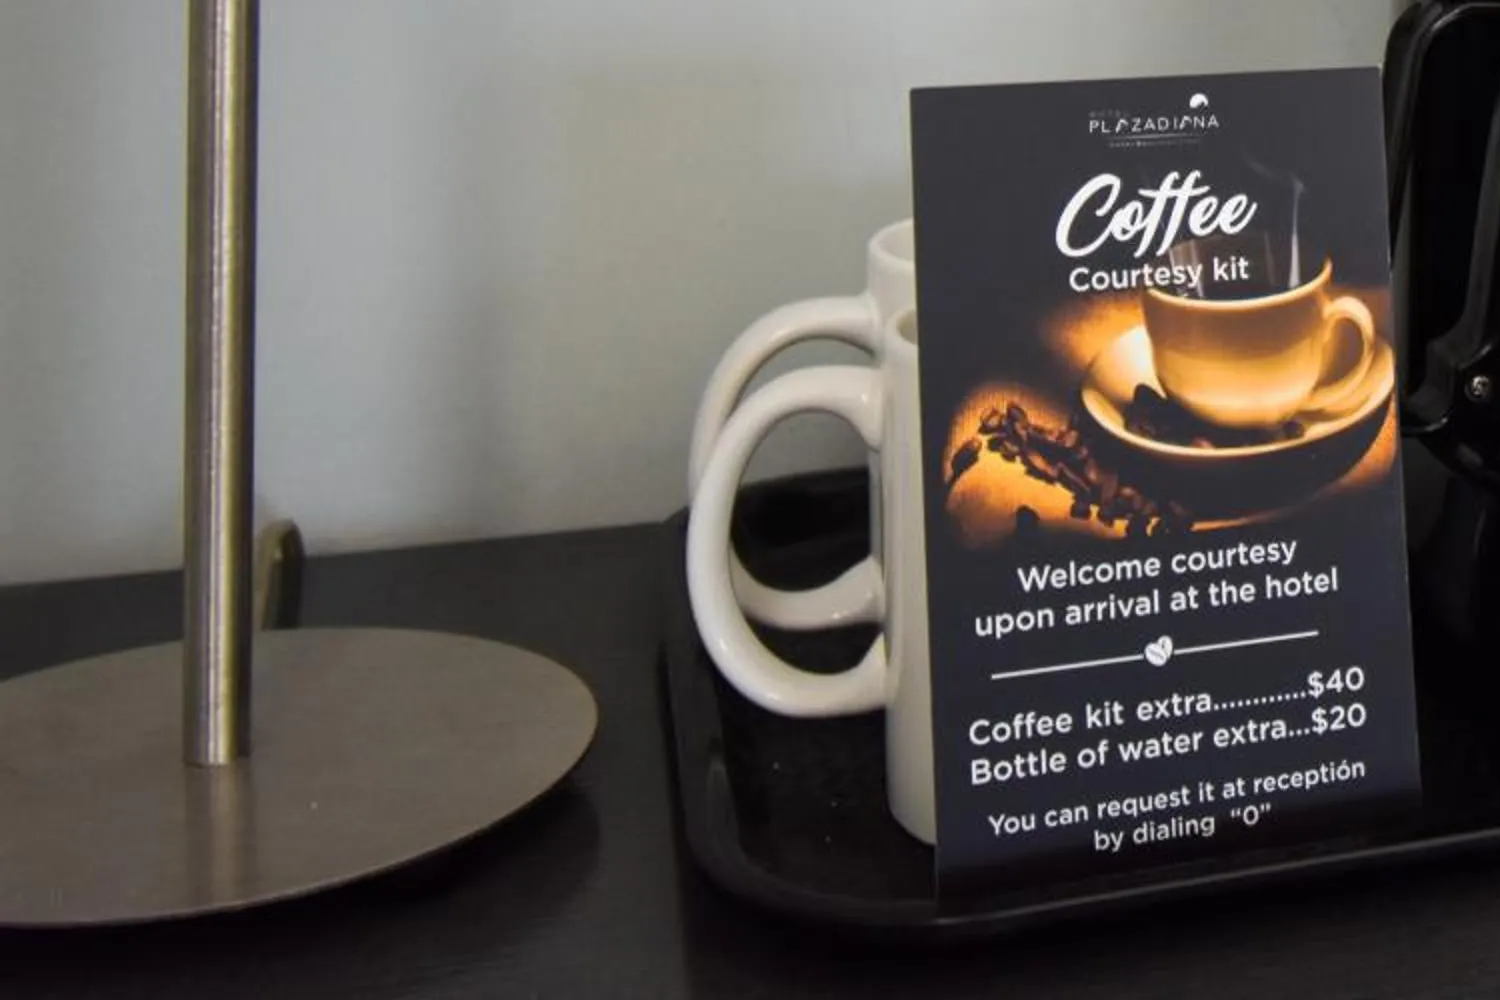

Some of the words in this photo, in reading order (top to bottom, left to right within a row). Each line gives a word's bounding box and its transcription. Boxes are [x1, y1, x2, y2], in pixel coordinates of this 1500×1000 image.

[1054, 168, 1259, 260] Coffee
[1068, 261, 1205, 293] Courtesy
[1212, 256, 1251, 283] kit
[1018, 556, 1160, 591] Welcome
[1170, 540, 1298, 575] courtesy
[974, 605, 1055, 639] upon
[1065, 590, 1160, 627] arrival
[1170, 586, 1201, 611] at
[1208, 580, 1257, 607] the
[1265, 567, 1339, 599] hotel
[968, 710, 1073, 746] Coffee
[1085, 702, 1125, 730] kit
[970, 748, 1068, 786] Bottle
[1077, 741, 1110, 770] of
[1118, 730, 1204, 764] water
[987, 812, 1037, 838] You
[1044, 804, 1090, 829] can
[1096, 786, 1191, 821] request
[1198, 785, 1215, 804] it
[1221, 779, 1247, 800] at
[1092, 829, 1126, 854] by
[1132, 812, 1216, 847] dialing
